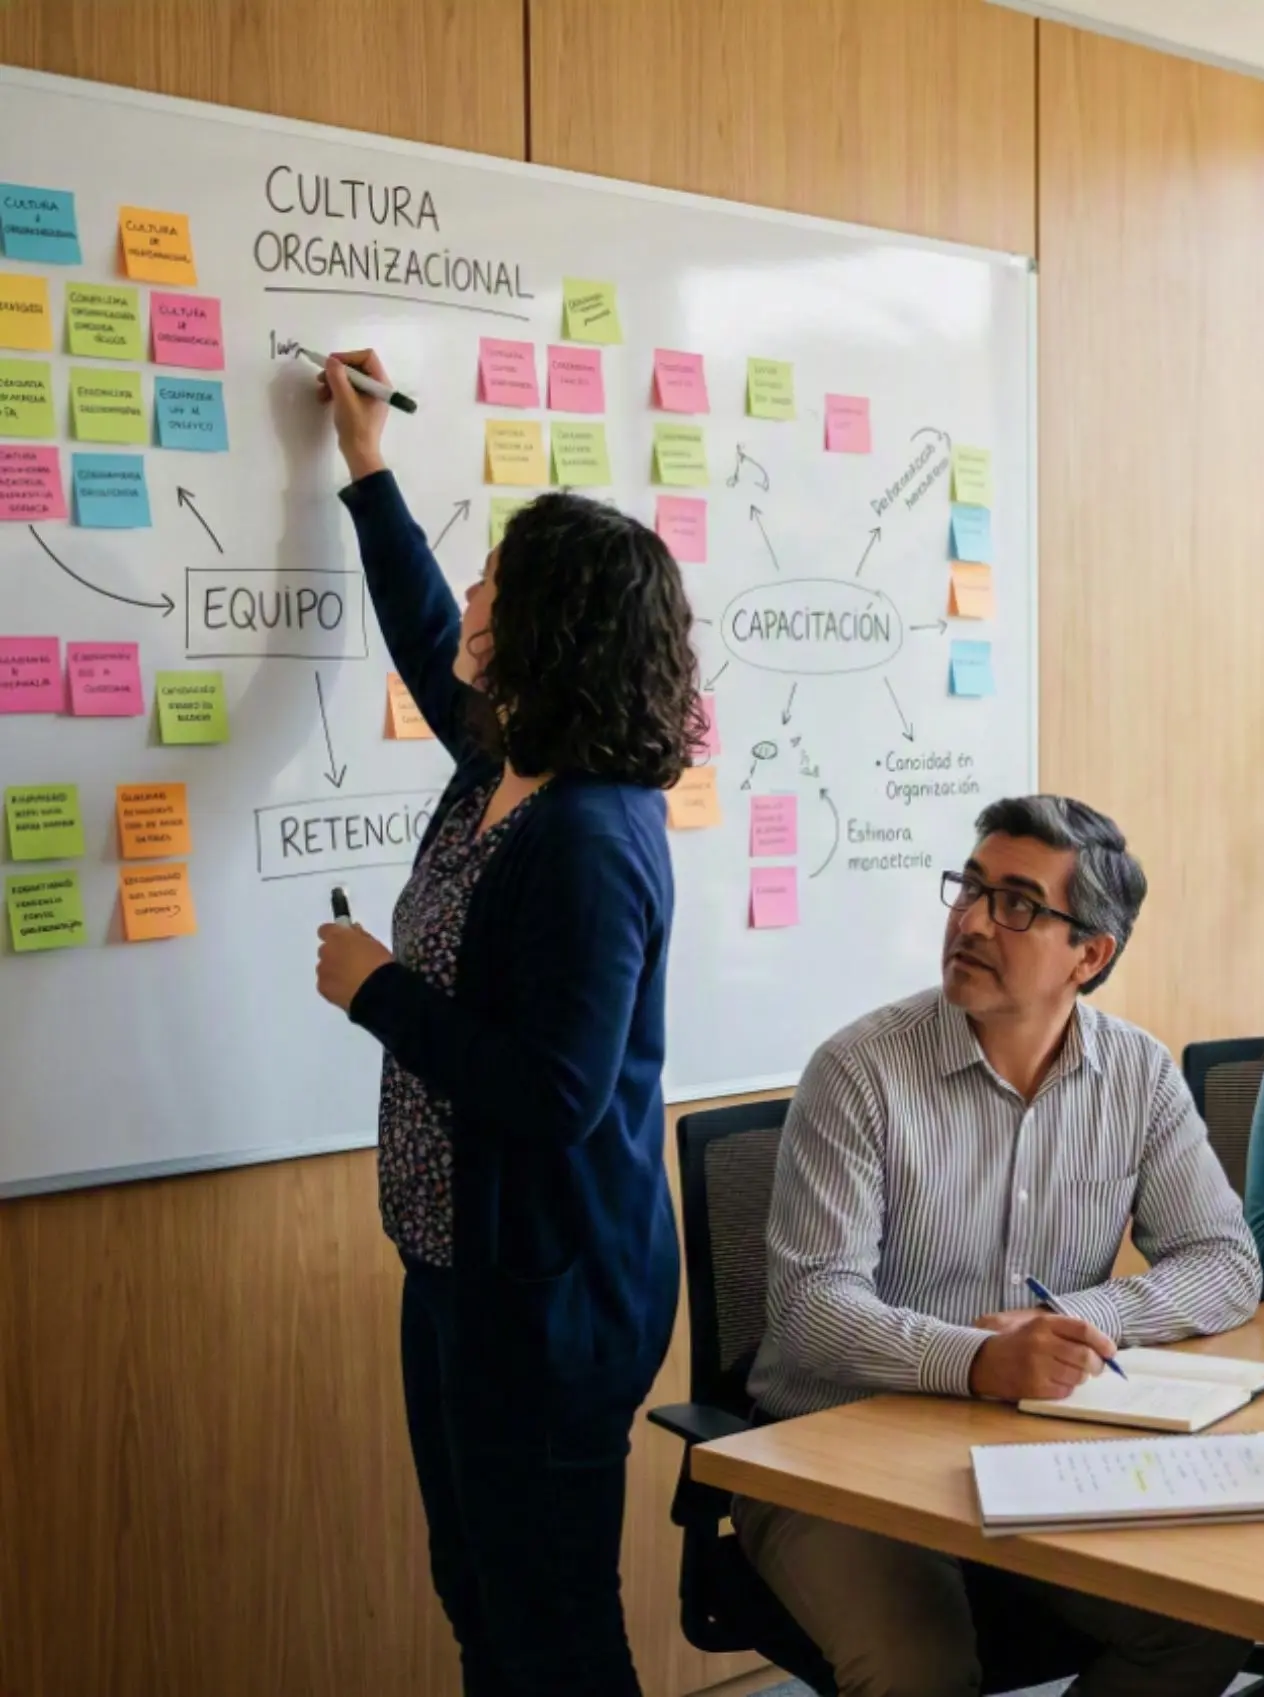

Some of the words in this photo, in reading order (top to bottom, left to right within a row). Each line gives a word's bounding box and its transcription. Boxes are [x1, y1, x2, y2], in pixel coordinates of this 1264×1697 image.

[265, 165, 440, 232] CULTURA
[253, 229, 536, 300] ORGANIZACIONAL
[203, 584, 344, 632] EQUIPO
[731, 601, 891, 642] CAPACITACIÓN
[885, 775, 981, 807] Organización
[279, 796, 433, 858] RETENCIÓ
